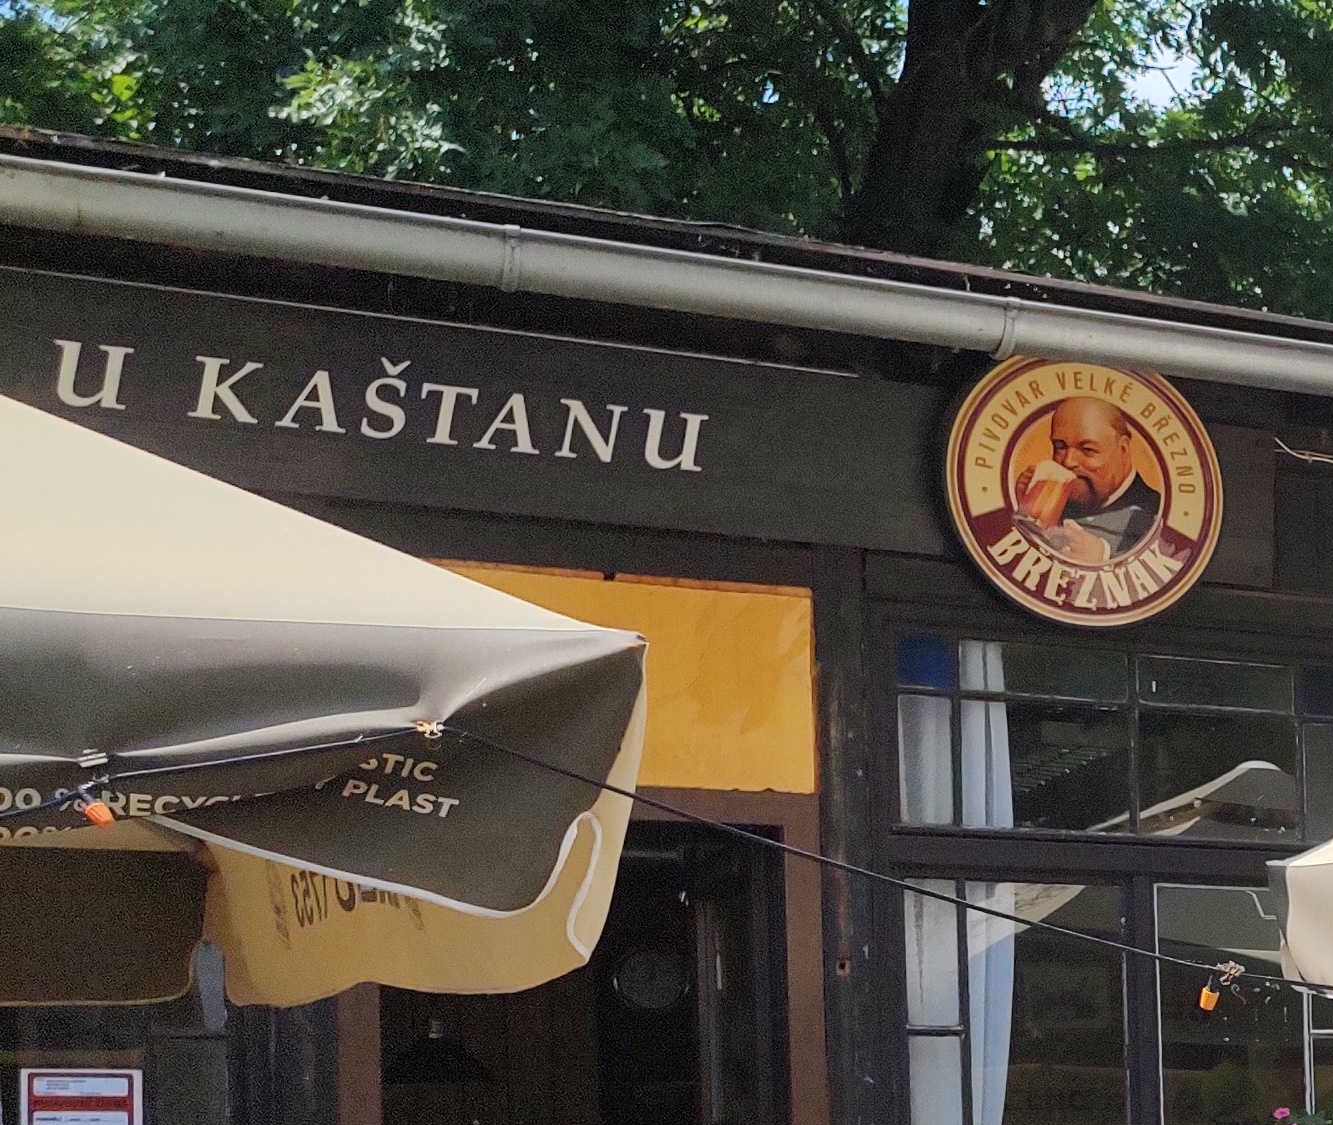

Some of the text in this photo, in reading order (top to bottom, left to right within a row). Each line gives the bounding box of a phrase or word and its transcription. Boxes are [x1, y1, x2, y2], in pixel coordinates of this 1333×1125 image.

[54, 340, 709, 472] U KAŠTANU
[974, 371, 1195, 495] PIVOVAR VELKÉ BŘEZNO
[987, 526, 1184, 610] BŘEZŇÁK
[342, 779, 460, 818] PLAST
